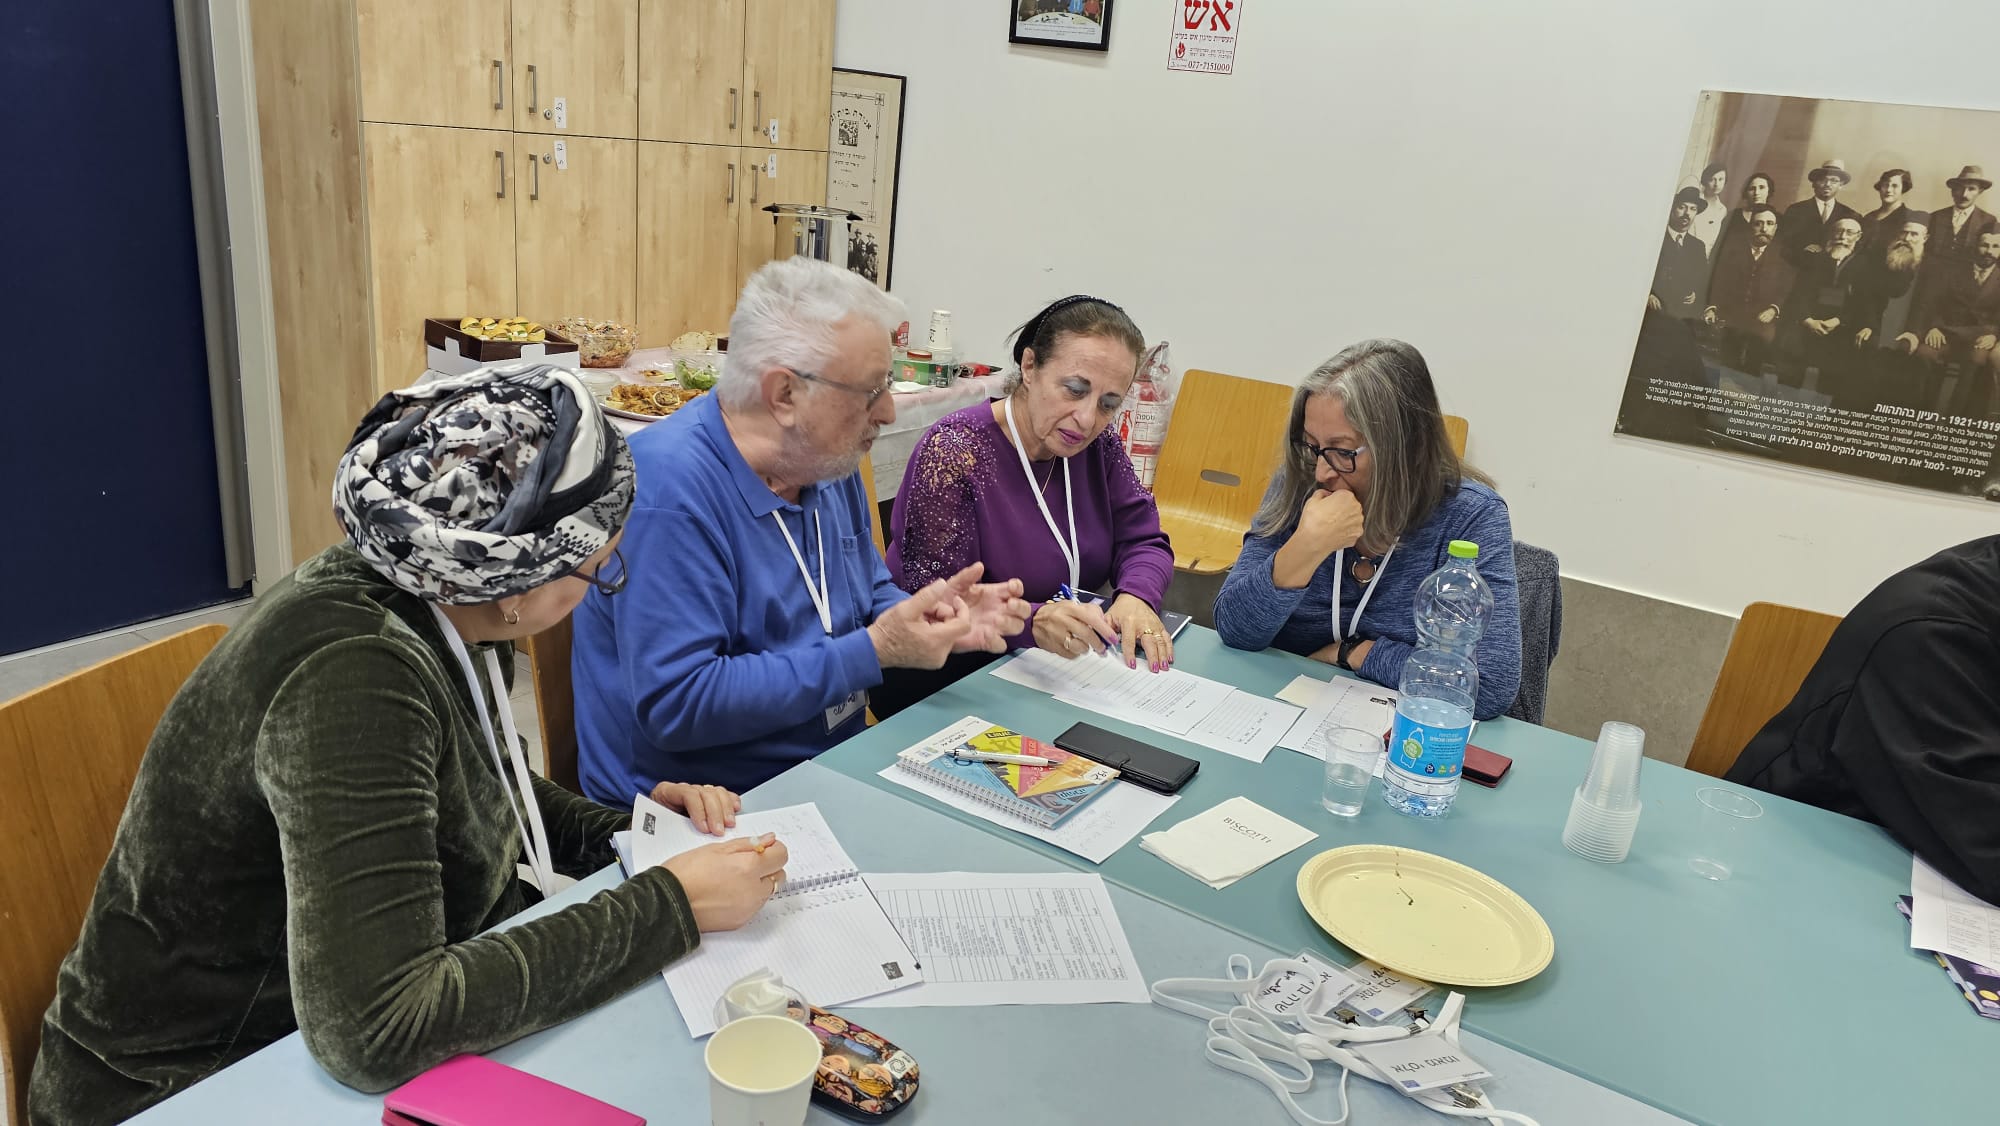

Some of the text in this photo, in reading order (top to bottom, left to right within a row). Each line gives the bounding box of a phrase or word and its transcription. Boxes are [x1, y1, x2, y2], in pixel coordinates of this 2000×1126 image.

[1184, 0, 1234, 31] אש
[1187, 60, 1230, 72] 077-7151000
[1645, 392, 1653, 400] של
[1873, 403, 1915, 418] בהתהוות
[1916, 410, 1939, 422] רעיון
[1806, 420, 1814, 428] של
[1949, 415, 2000, 432] 1921-1919
[1966, 429, 1975, 437] של
[1777, 435, 1799, 445] ולצידו
[1799, 439, 1813, 448] בית
[1880, 441, 1889, 449] של
[1814, 442, 1831, 451] להם
[1831, 445, 1856, 456] להקים
[1856, 449, 1891, 462] המייסדים
[1891, 455, 1908, 465] רצון
[1908, 458, 1923, 467] את
[1924, 459, 1945, 471] לסמל
[1952, 465, 1965, 475] וגן"
[1965, 468, 1986, 477] "בית
[1222, 816, 1272, 843] BISCOTTI
